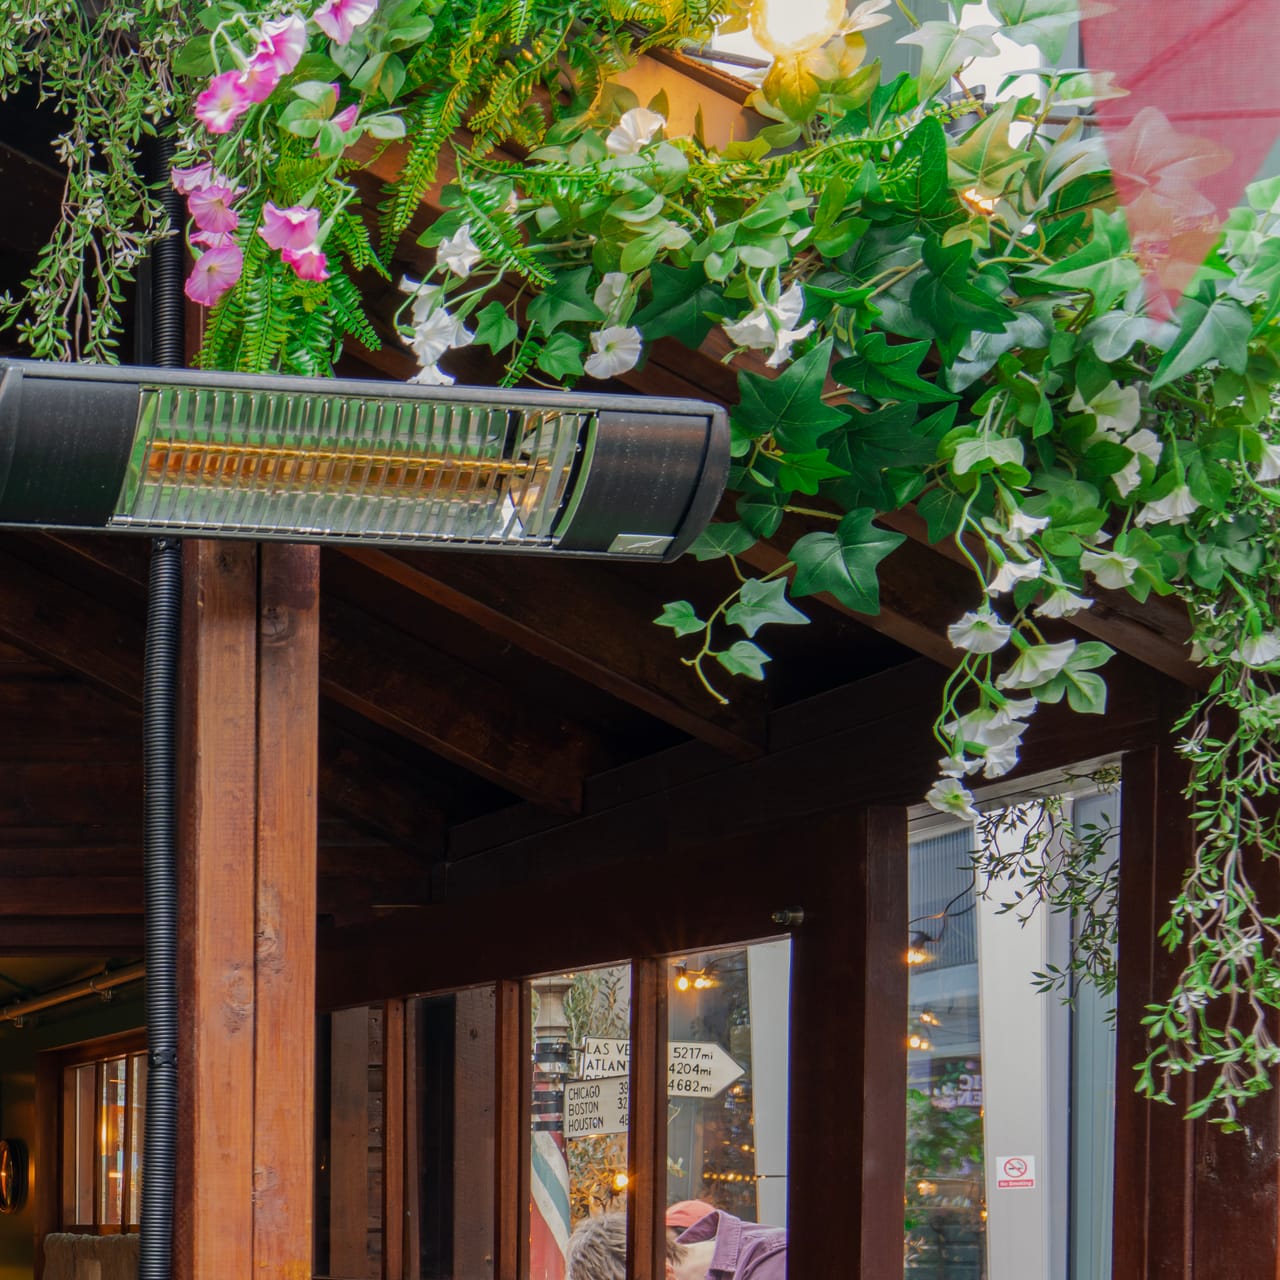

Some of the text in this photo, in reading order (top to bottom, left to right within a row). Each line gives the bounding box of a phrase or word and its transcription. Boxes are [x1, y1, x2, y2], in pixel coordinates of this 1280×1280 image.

[586, 1042, 610, 1055] LAS
[568, 1085, 600, 1101] CHICAGO
[568, 1101, 599, 1116] BOSTON
[568, 1117, 604, 1133] HOUSTON
